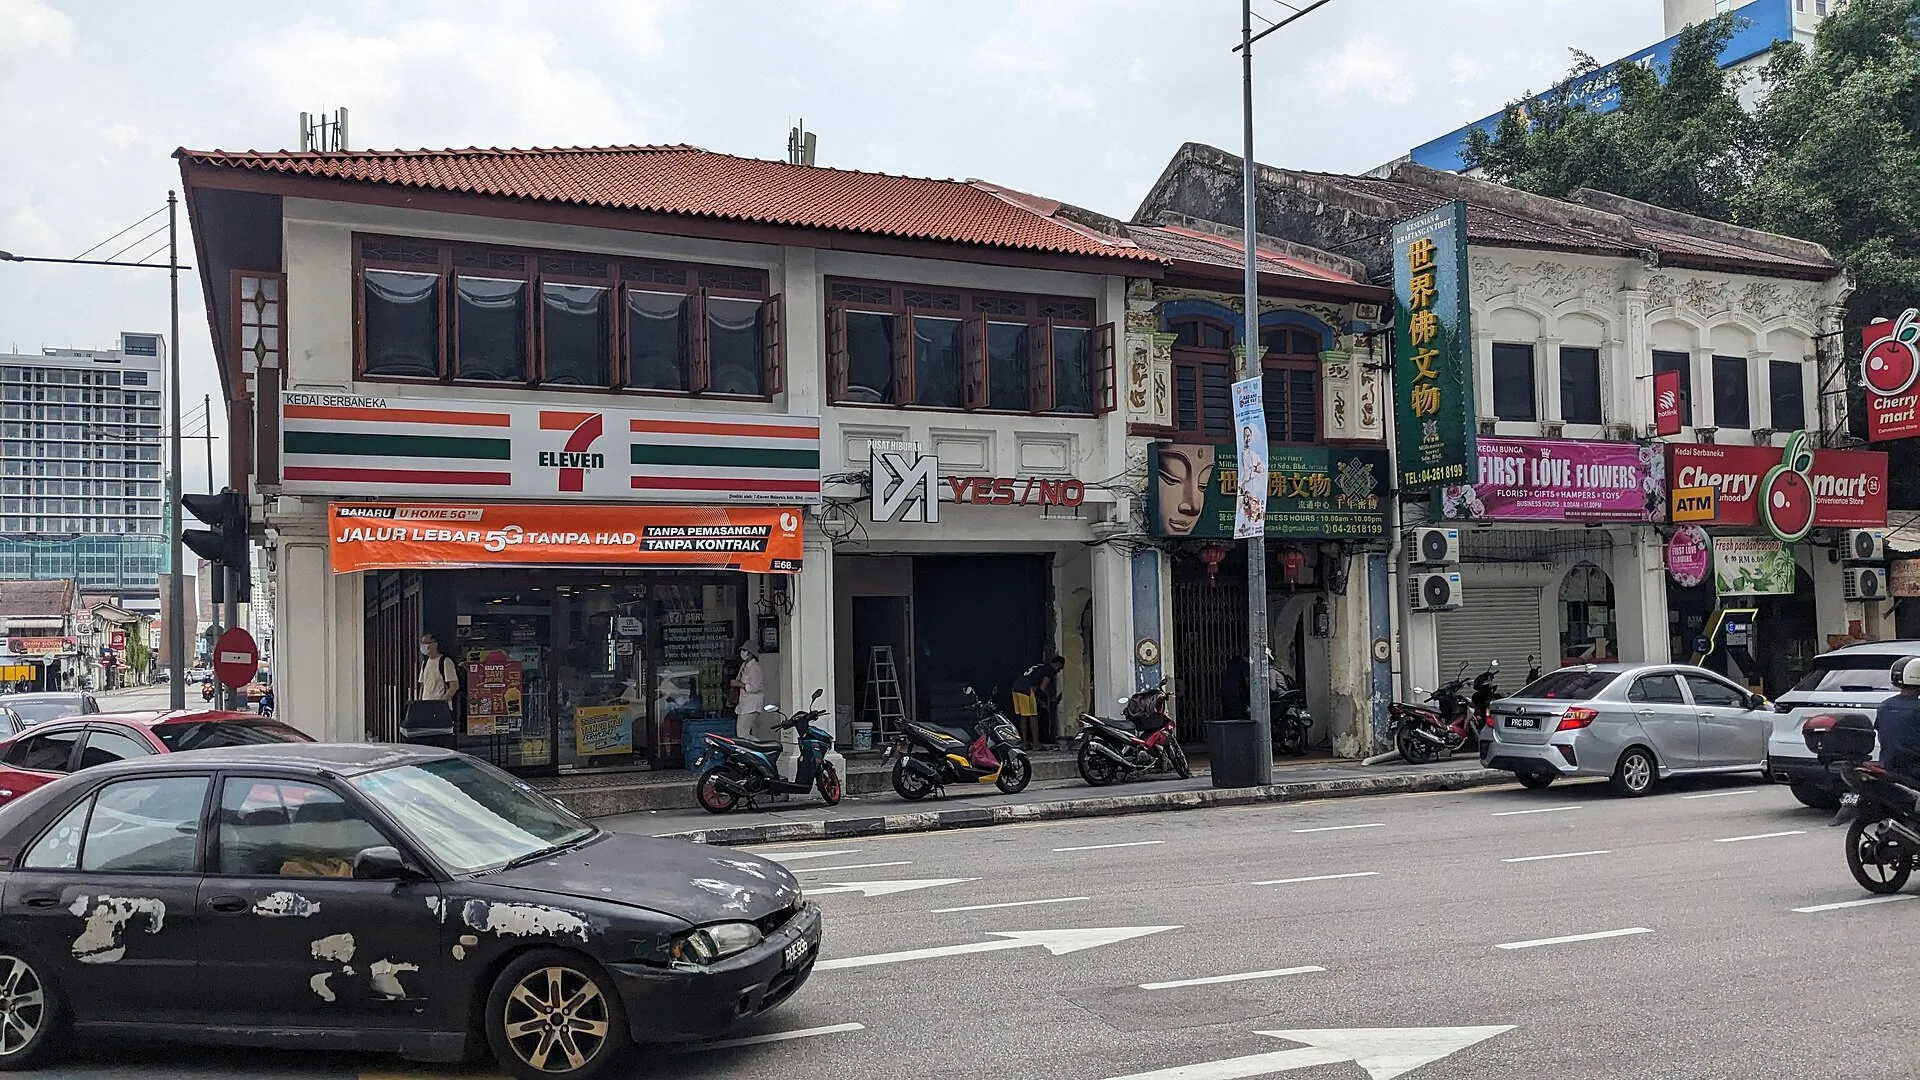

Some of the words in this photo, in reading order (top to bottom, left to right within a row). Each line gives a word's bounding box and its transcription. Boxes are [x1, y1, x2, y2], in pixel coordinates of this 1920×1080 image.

[1396, 224, 1434, 244] KRAFTANGAN
[1434, 218, 1451, 230] TIBET
[1406, 216, 1434, 231] KESENIAN
[1408, 238, 1440, 418] 世界佛文物
[286, 394, 319, 405] KEDAI
[322, 396, 387, 408] SERBANEKA
[1874, 395, 1918, 410] Cherry
[1880, 408, 1914, 424] mart
[868, 440, 890, 450] PUSAT
[890, 442, 922, 452] HIBURAN
[1675, 448, 1692, 456] Kedai
[1693, 448, 1724, 457] Serbaneka
[1405, 472, 1417, 484] TEL
[1446, 464, 1462, 478] 8199
[1478, 456, 1526, 486] FIRST
[1532, 458, 1572, 487] LOVE
[1576, 464, 1637, 489] FLOWERS
[948, 476, 1015, 506] YES
[1038, 478, 1084, 507] NO
[1678, 466, 1758, 502] Cherry
[1813, 474, 1866, 496] mart
[1676, 496, 1711, 512] ATM
[341, 508, 391, 517] BAHARU
[648, 528, 685, 536] TANPA
[688, 526, 767, 536] PEMASANGAN
[1333, 525, 1382, 533] 04-2618199
[336, 528, 406, 543] JALUR
[412, 529, 480, 542] LEBAR
[483, 525, 524, 552] 5G
[526, 532, 589, 545] TANPA
[595, 533, 636, 545] HAD
[647, 540, 692, 550] TANPA
[696, 539, 761, 550] KONTRAK
[1686, 546, 1697, 554] LOVE
[1715, 540, 1733, 551] Fresh
[1734, 541, 1758, 553] pandan
